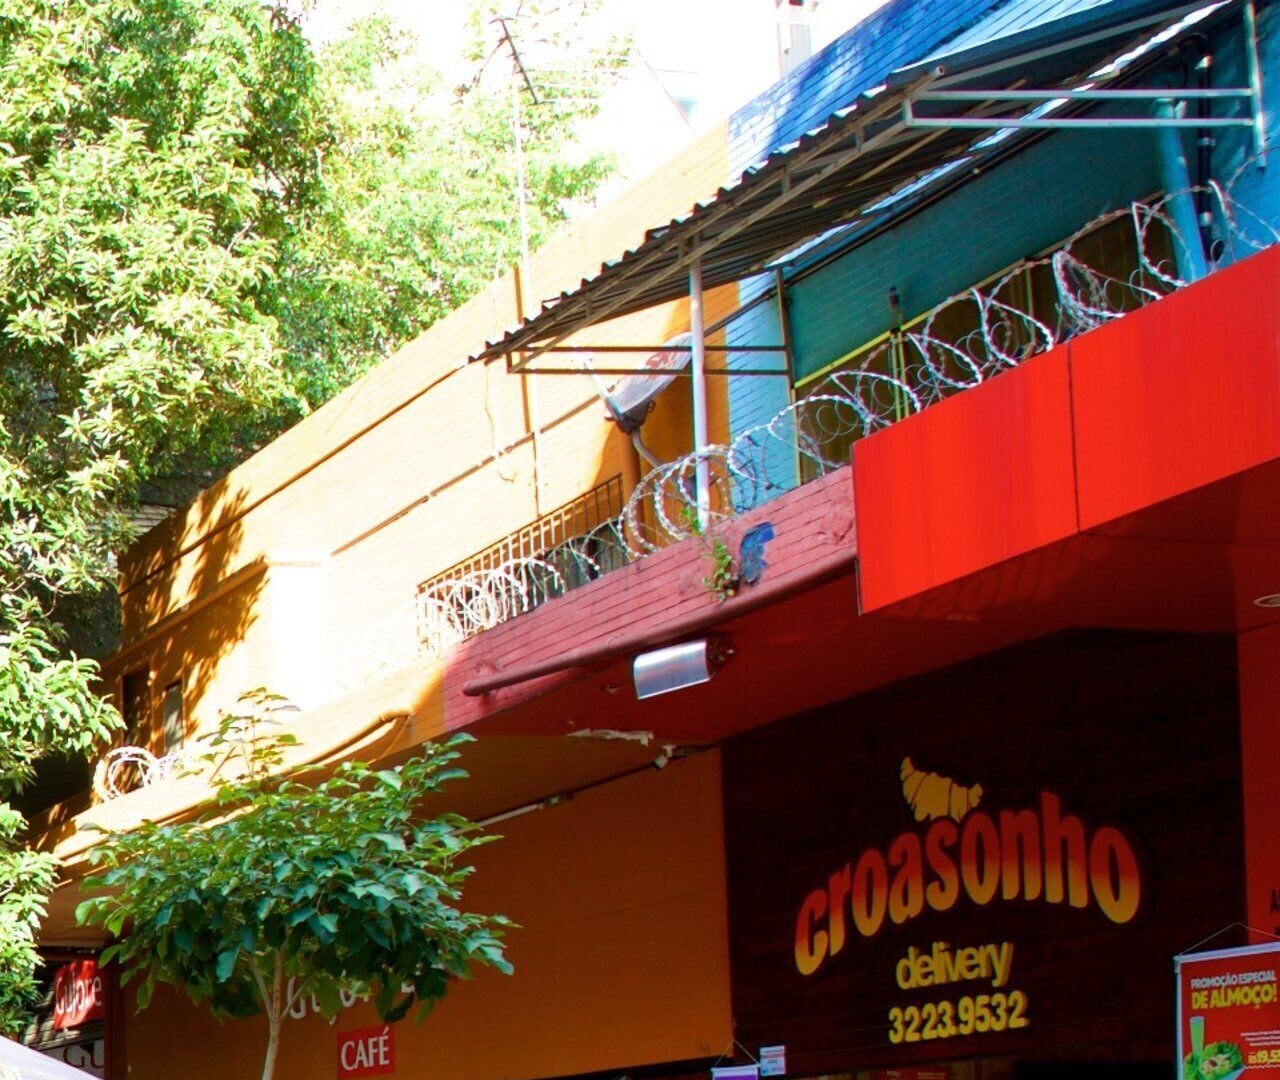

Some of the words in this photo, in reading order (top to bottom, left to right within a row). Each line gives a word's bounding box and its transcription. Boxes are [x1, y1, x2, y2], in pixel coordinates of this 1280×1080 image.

[795, 791, 1140, 976] croasonho
[896, 941, 1014, 990] delivery
[888, 990, 1029, 1044] 3223.9532
[1192, 990, 1208, 1010] DE
[1210, 984, 1277, 1009] ALMOÇO!
[341, 1026, 390, 1070] CAFÉ
